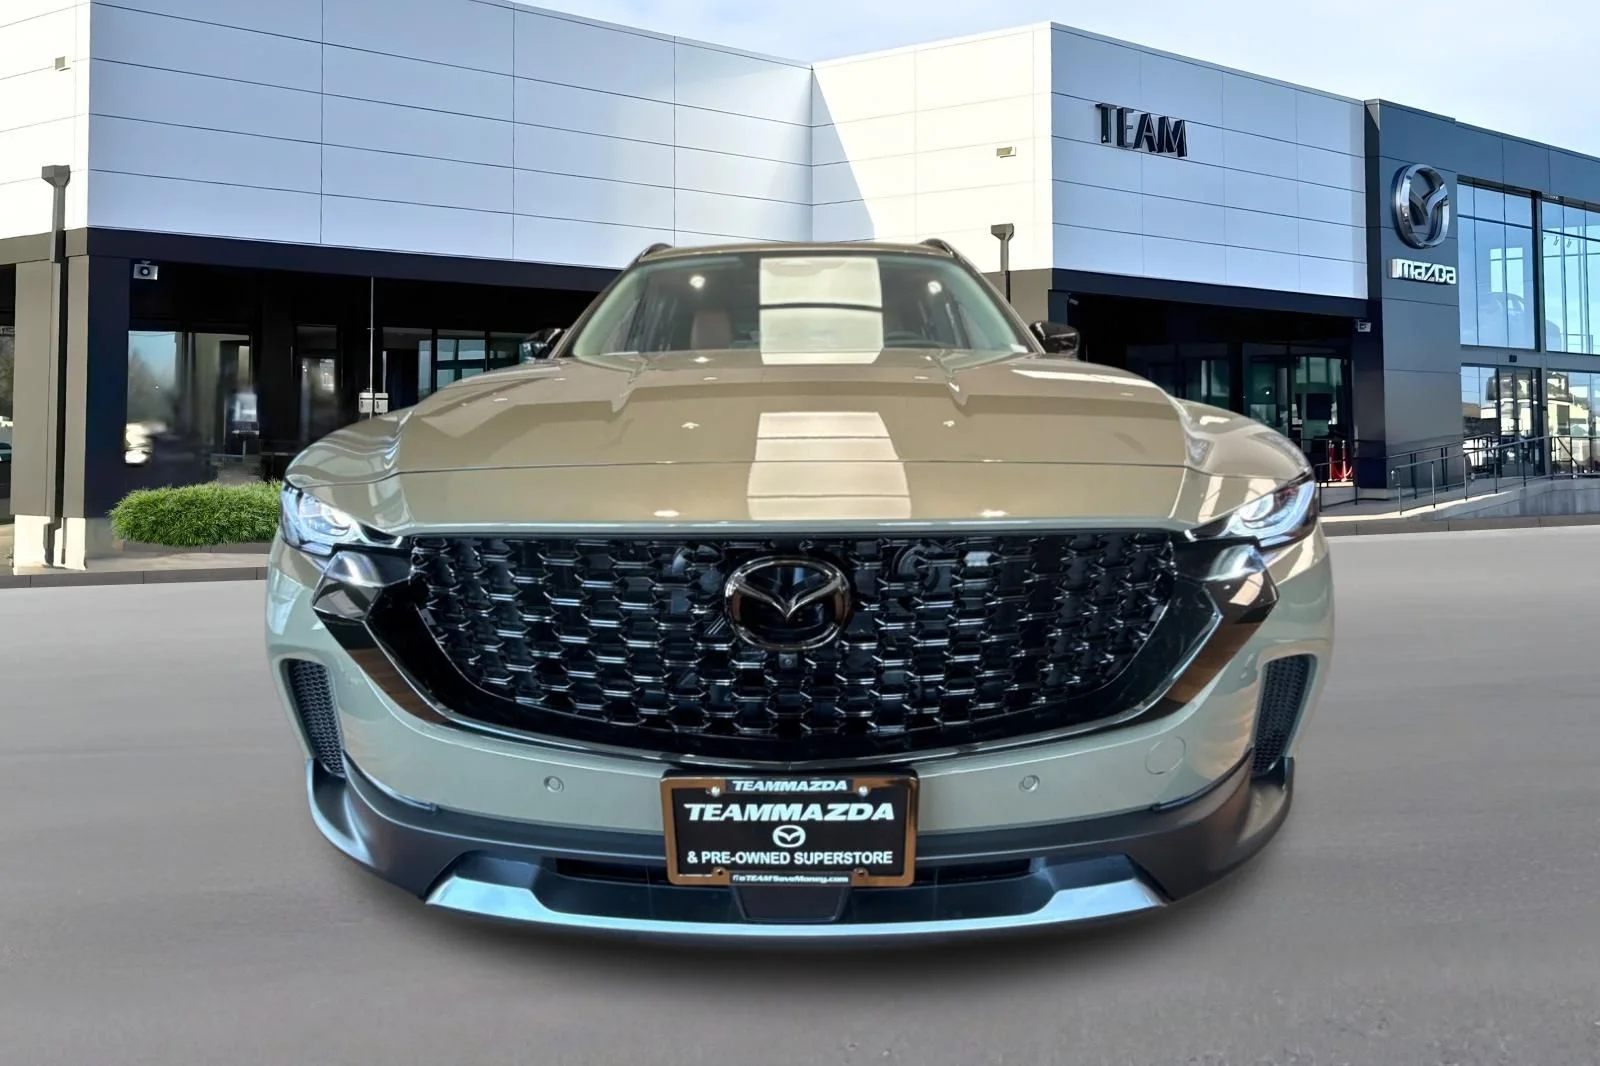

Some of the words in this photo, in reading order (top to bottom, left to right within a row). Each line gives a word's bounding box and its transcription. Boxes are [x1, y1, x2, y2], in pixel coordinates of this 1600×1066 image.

[1095, 103, 1187, 157] TEAM
[732, 780, 847, 791] TEAMMAZDA
[684, 803, 894, 821] TEAMMAZDA
[687, 851, 698, 864] &
[701, 851, 790, 864] PRE-OWNED
[794, 851, 893, 864] SUPERSTORE
